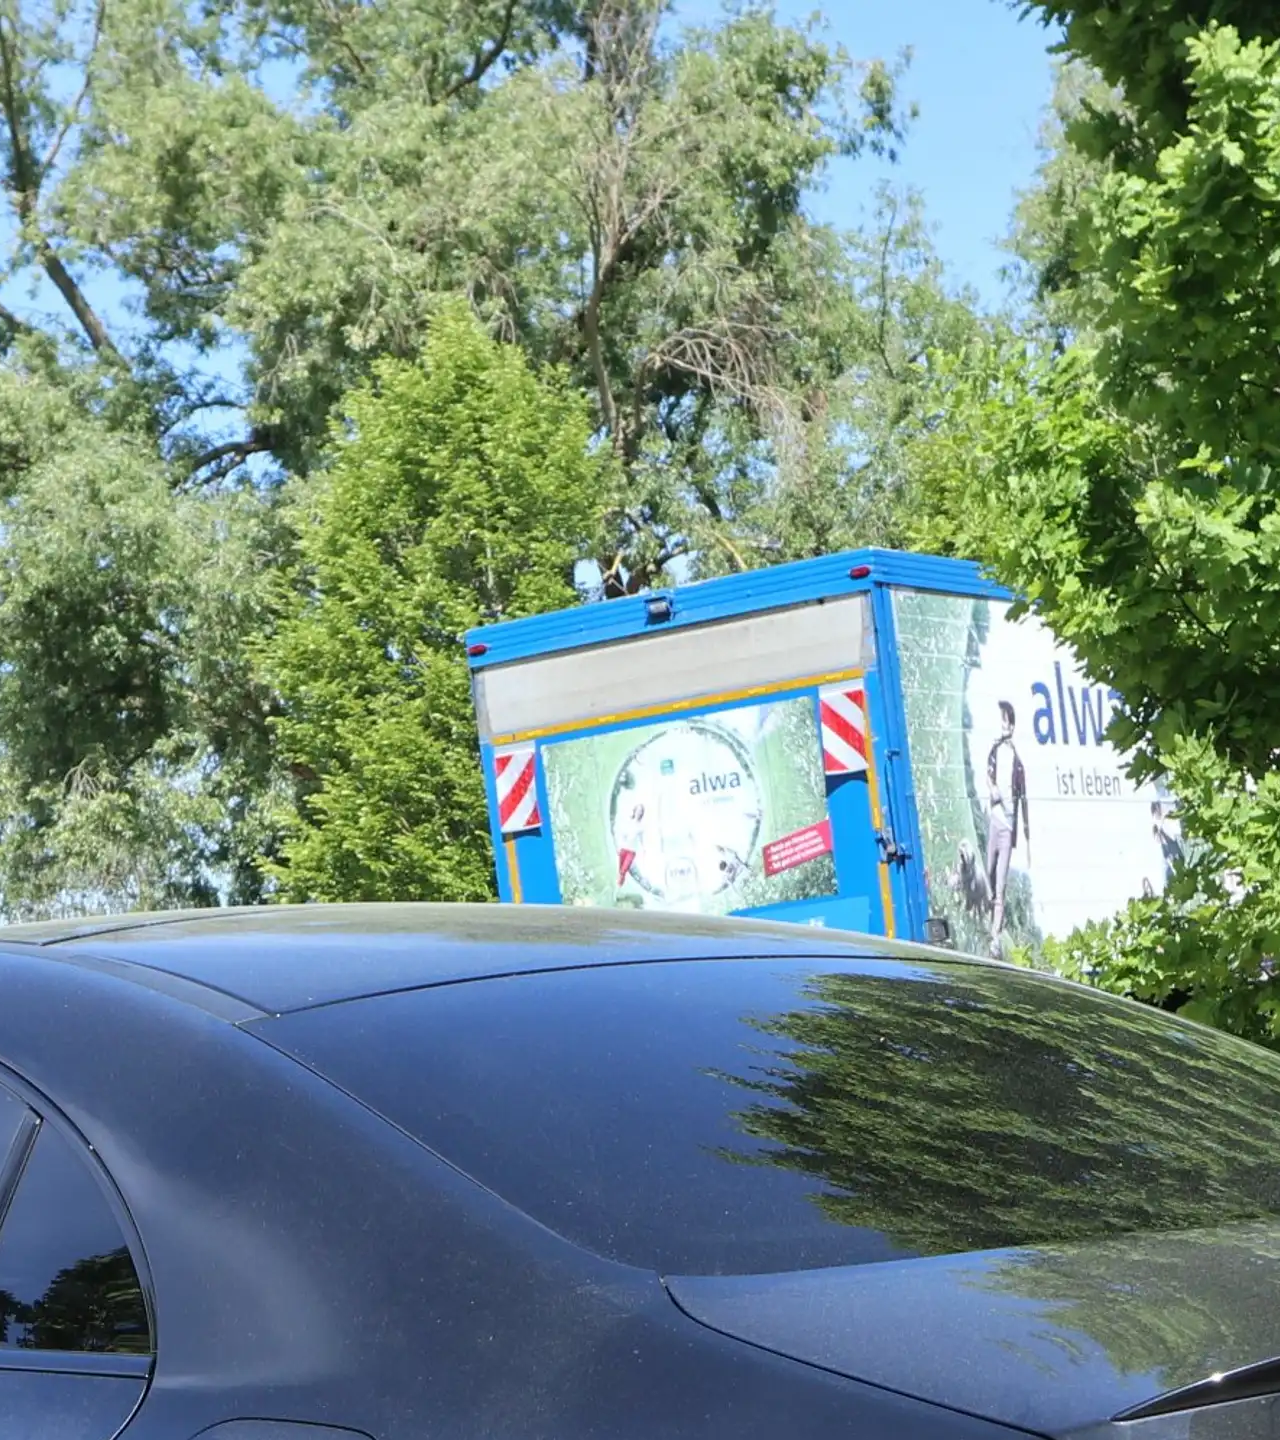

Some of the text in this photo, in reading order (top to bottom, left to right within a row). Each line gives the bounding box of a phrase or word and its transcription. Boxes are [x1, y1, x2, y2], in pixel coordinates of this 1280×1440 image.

[689, 771, 741, 795] alwa
[1056, 765, 1122, 796] ist leben
